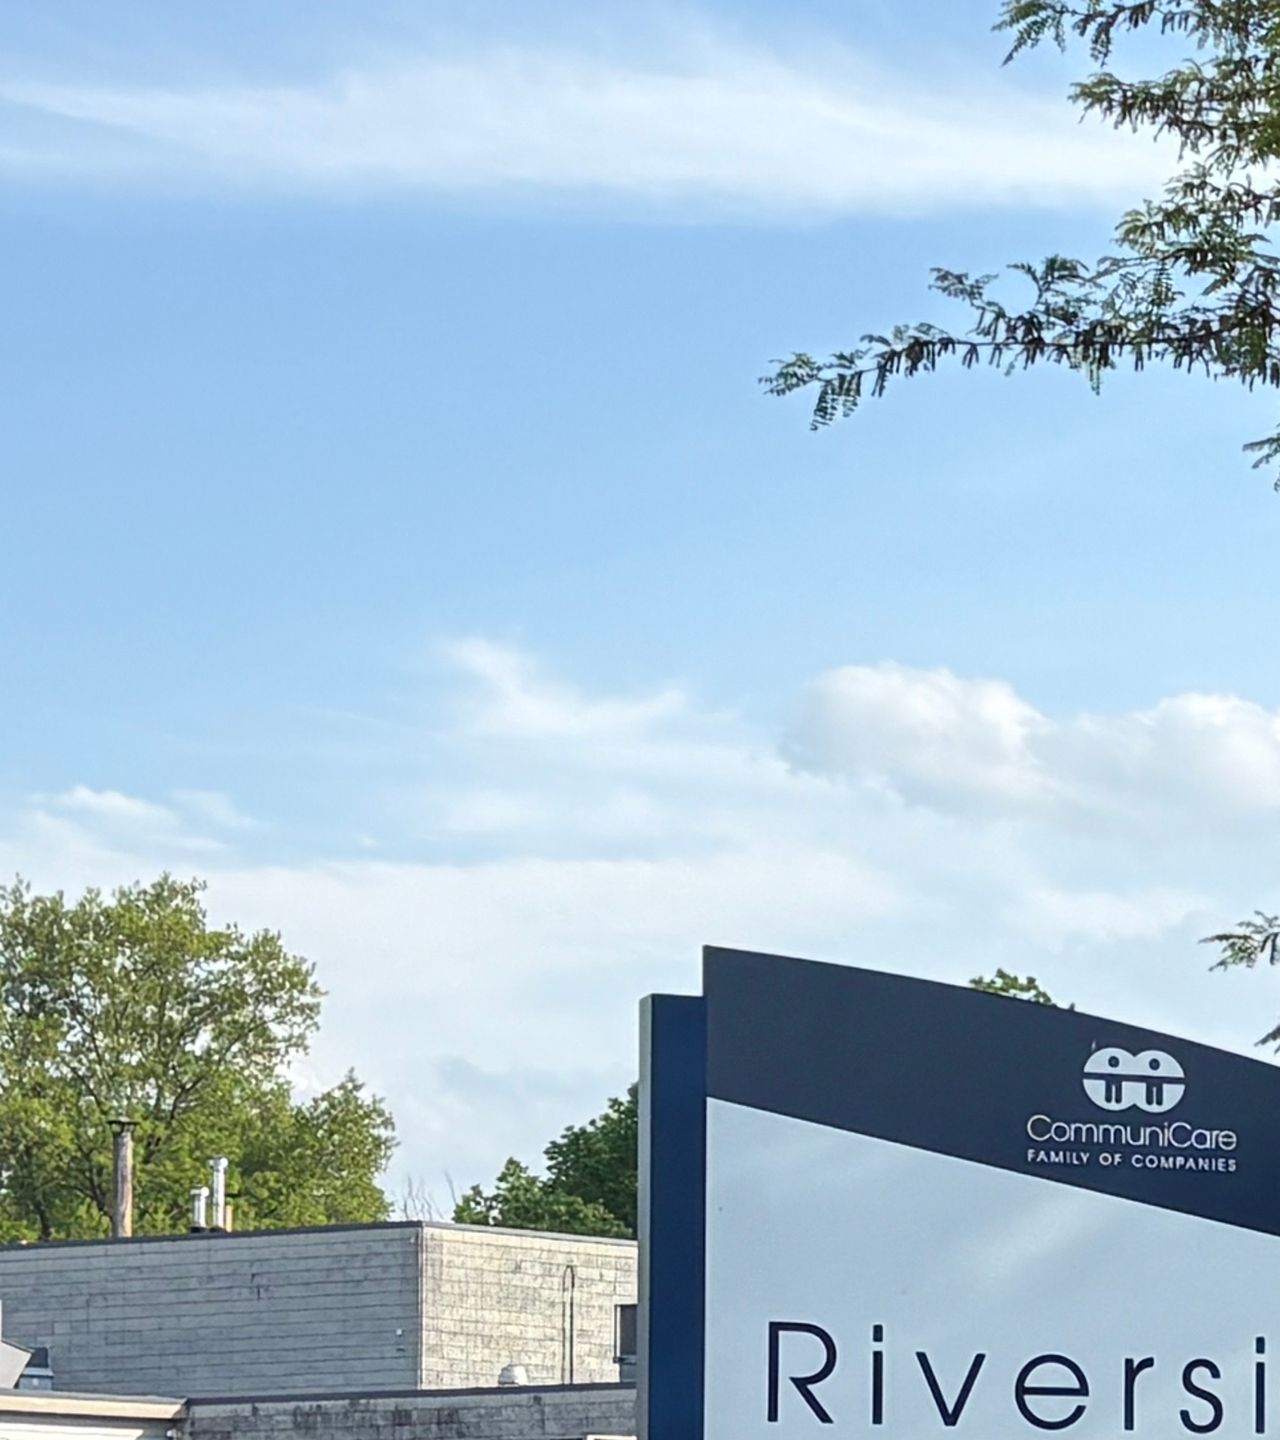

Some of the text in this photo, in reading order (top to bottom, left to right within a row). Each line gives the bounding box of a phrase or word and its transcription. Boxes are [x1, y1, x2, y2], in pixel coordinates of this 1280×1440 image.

[1026, 1114, 1237, 1150] CommuniCare
[1027, 1148, 1237, 1172] FAMILY OF COMPANIES
